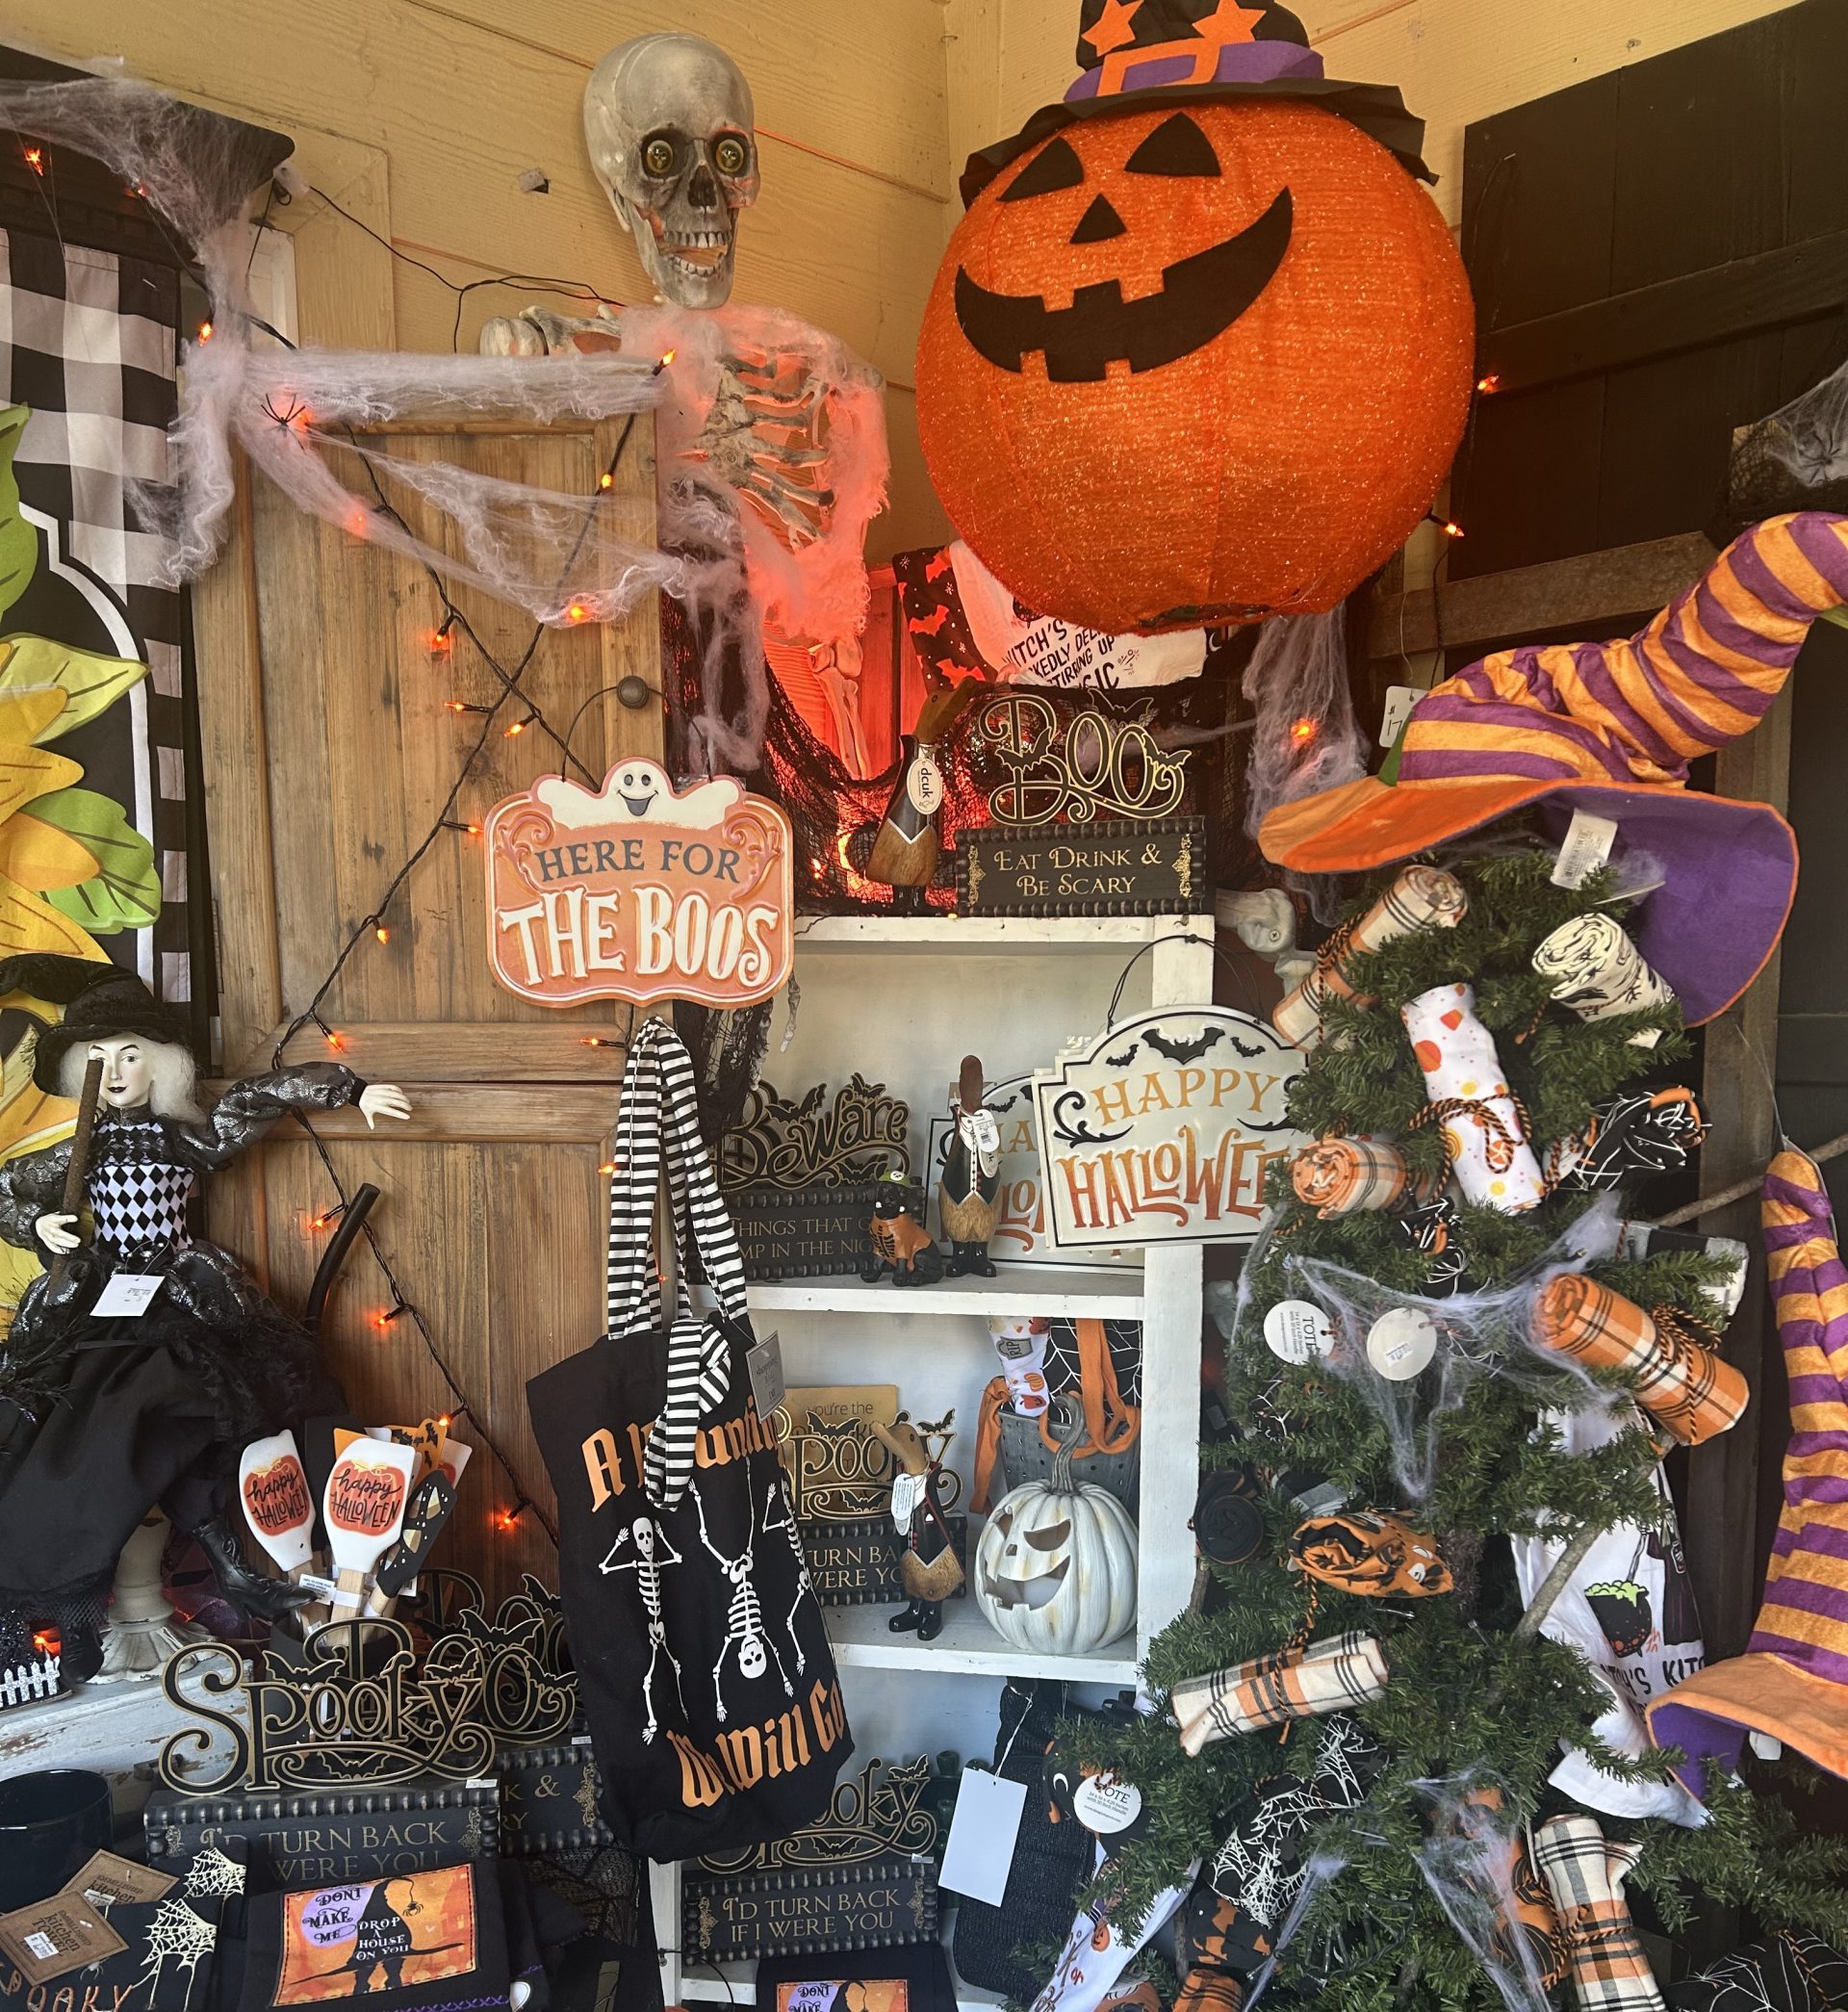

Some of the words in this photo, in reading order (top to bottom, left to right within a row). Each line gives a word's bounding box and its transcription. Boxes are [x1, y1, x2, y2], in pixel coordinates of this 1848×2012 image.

[1002, 619, 1067, 667] ITCH'S
[1028, 643, 1070, 679] KEDLY
[1075, 627, 1101, 652] DEL
[1097, 635, 1116, 655] UP
[921, 767, 934, 798] dcuk
[535, 839, 645, 883] HERE
[660, 839, 740, 884] FOR
[1141, 843, 1163, 865] &
[499, 886, 626, 986] THE
[632, 886, 779, 988] BOOS
[1091, 1068, 1281, 1126] HAPPY
[1055, 1124, 1291, 1229] HALLOWEE
[730, 1217, 796, 1237] THINGS
[803, 1217, 852, 1234] THAT
[739, 1244, 765, 1260] MP
[772, 1243, 790, 1258] IN
[797, 1240, 834, 1256] THE
[1006, 1341, 1022, 1355] RIP
[852, 1401, 874, 1415] the
[247, 1468, 298, 1502] happy
[334, 1469, 402, 1500] happy
[581, 1428, 626, 1512] A
[252, 1484, 308, 1528] HALLOWEEN
[331, 1492, 399, 1528] HALLOWEEN
[875, 1566, 903, 1585] YO
[715, 1704, 811, 1793] Will
[534, 1774, 561, 1798] &
[259, 1828, 351, 1853] TURN
[362, 1821, 449, 1849] BACK
[87, 1879, 137, 1904] kitchen
[723, 1896, 758, 1922] I'D
[766, 1895, 832, 1918] TURN
[838, 1889, 901, 1912] BACK
[44, 1913, 81, 1951] kitchen
[301, 1906, 354, 1929] MAKE
[359, 1916, 401, 1931] DROP
[767, 1918, 834, 1939] WERE
[843, 1912, 895, 1932] YOU
[314, 1924, 357, 1944] ME
[358, 1934, 406, 1949] HOUSE
[355, 1951, 376, 1961] ON
[382, 1945, 409, 1955] YOU
